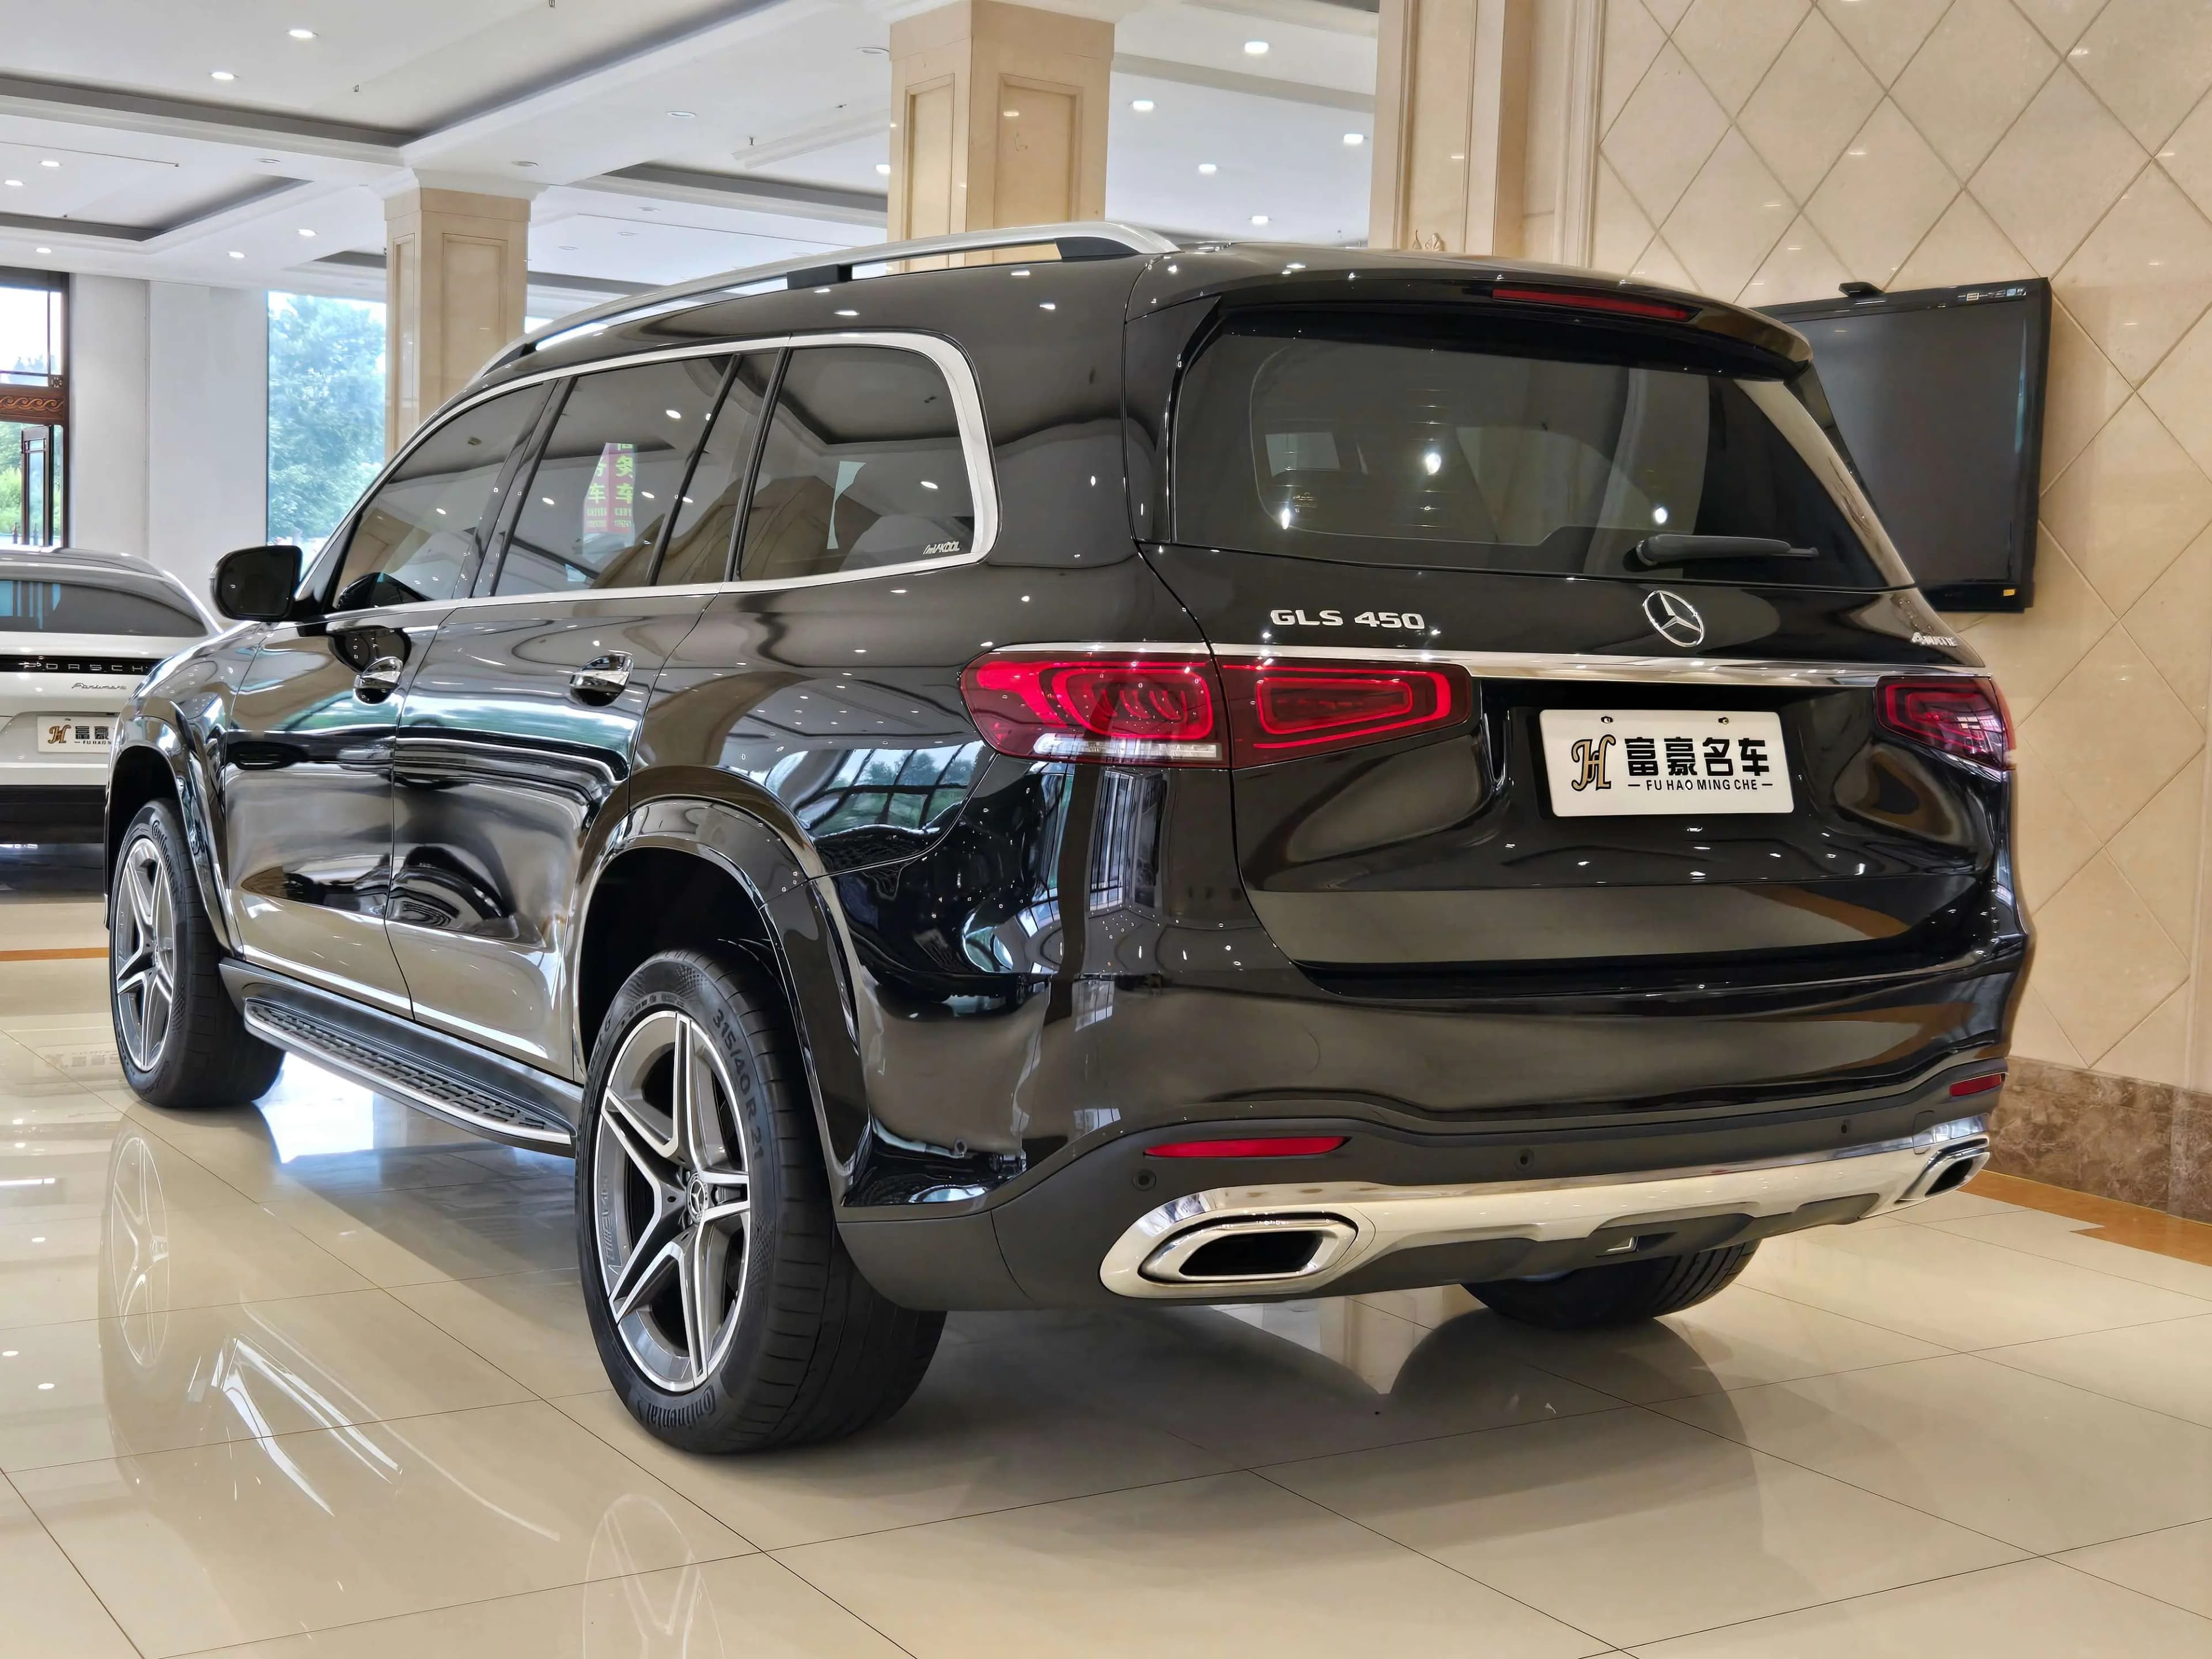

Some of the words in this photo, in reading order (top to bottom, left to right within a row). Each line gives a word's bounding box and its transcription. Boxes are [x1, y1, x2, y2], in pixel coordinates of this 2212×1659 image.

[1270, 609, 1343, 626] GLS
[1354, 612, 1425, 630] 450
[22, 662, 143, 672] PORSCH
[75, 726, 108, 740] 富豪
[1624, 736, 1770, 777] 富豪名车
[1646, 779, 1662, 791] FU
[1666, 779, 1694, 791] HAO
[1696, 779, 1731, 790] MING
[1734, 779, 1758, 790] CHE
[712, 1008, 752, 1096] 315/40
[751, 1123, 764, 1161] 21
